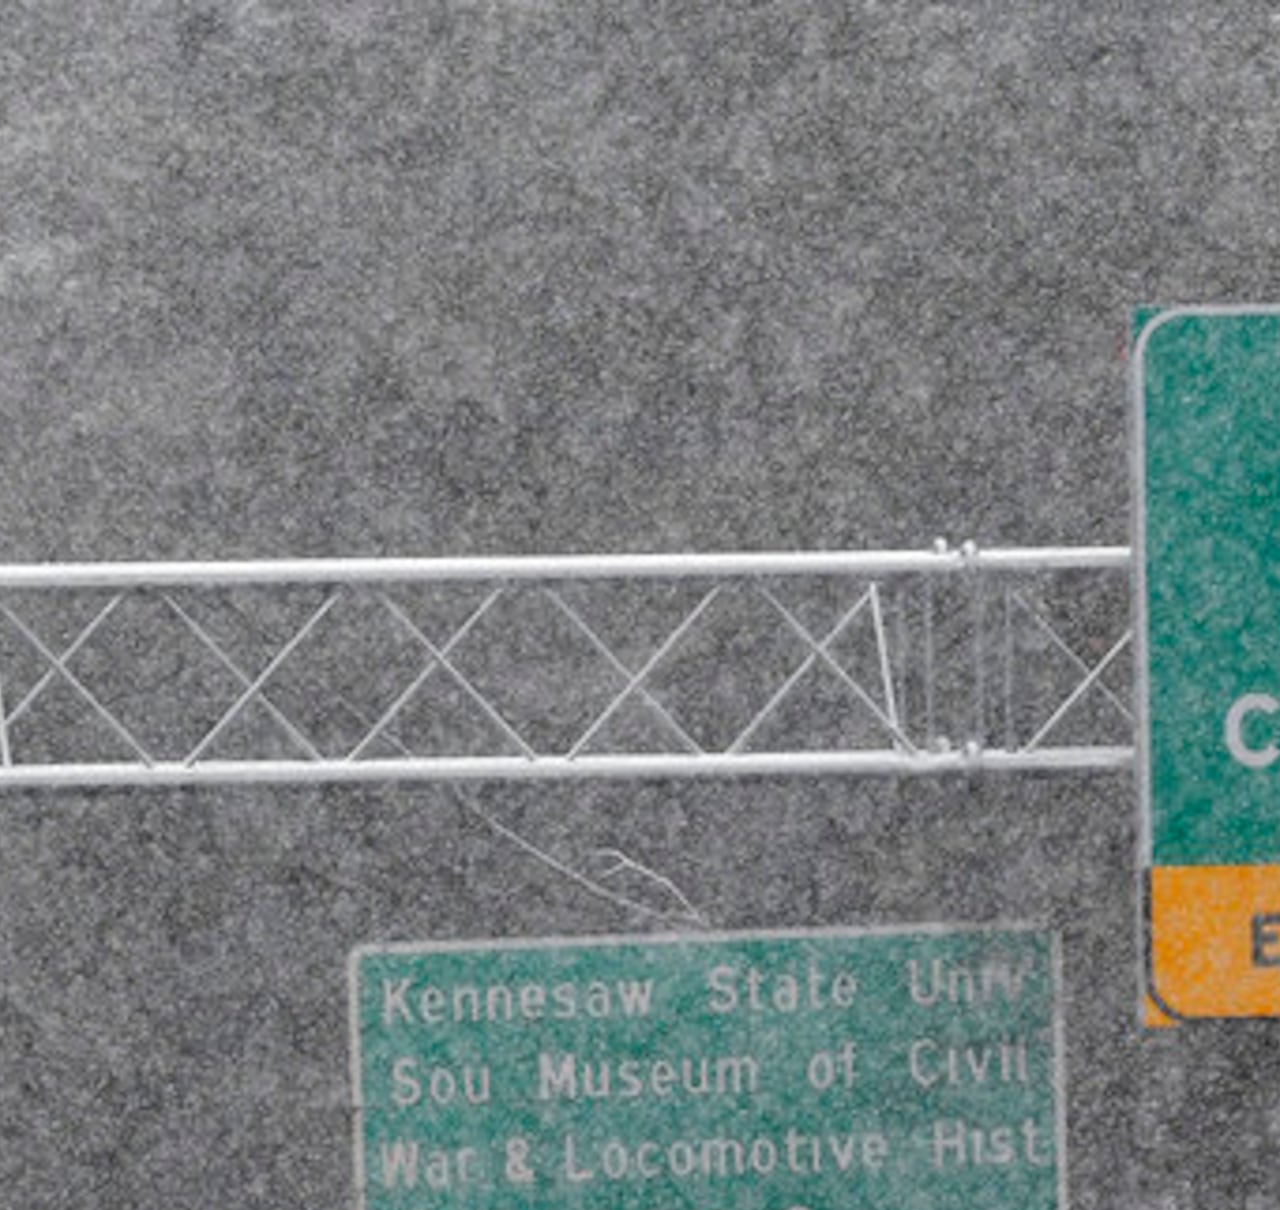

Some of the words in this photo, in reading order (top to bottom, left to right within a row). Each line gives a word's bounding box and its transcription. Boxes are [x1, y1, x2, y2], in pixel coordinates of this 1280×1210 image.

[381, 976, 653, 1025] Kennesaw
[708, 964, 858, 1012] State
[391, 1056, 491, 1105] Sou
[537, 1052, 760, 1100] Museum
[807, 1040, 858, 1089] of
[909, 1037, 1029, 1087] Civil
[380, 1138, 477, 1190] War
[505, 1137, 535, 1183] &
[564, 1125, 888, 1182] Locomotive
[932, 1116, 1051, 1169] Hist
